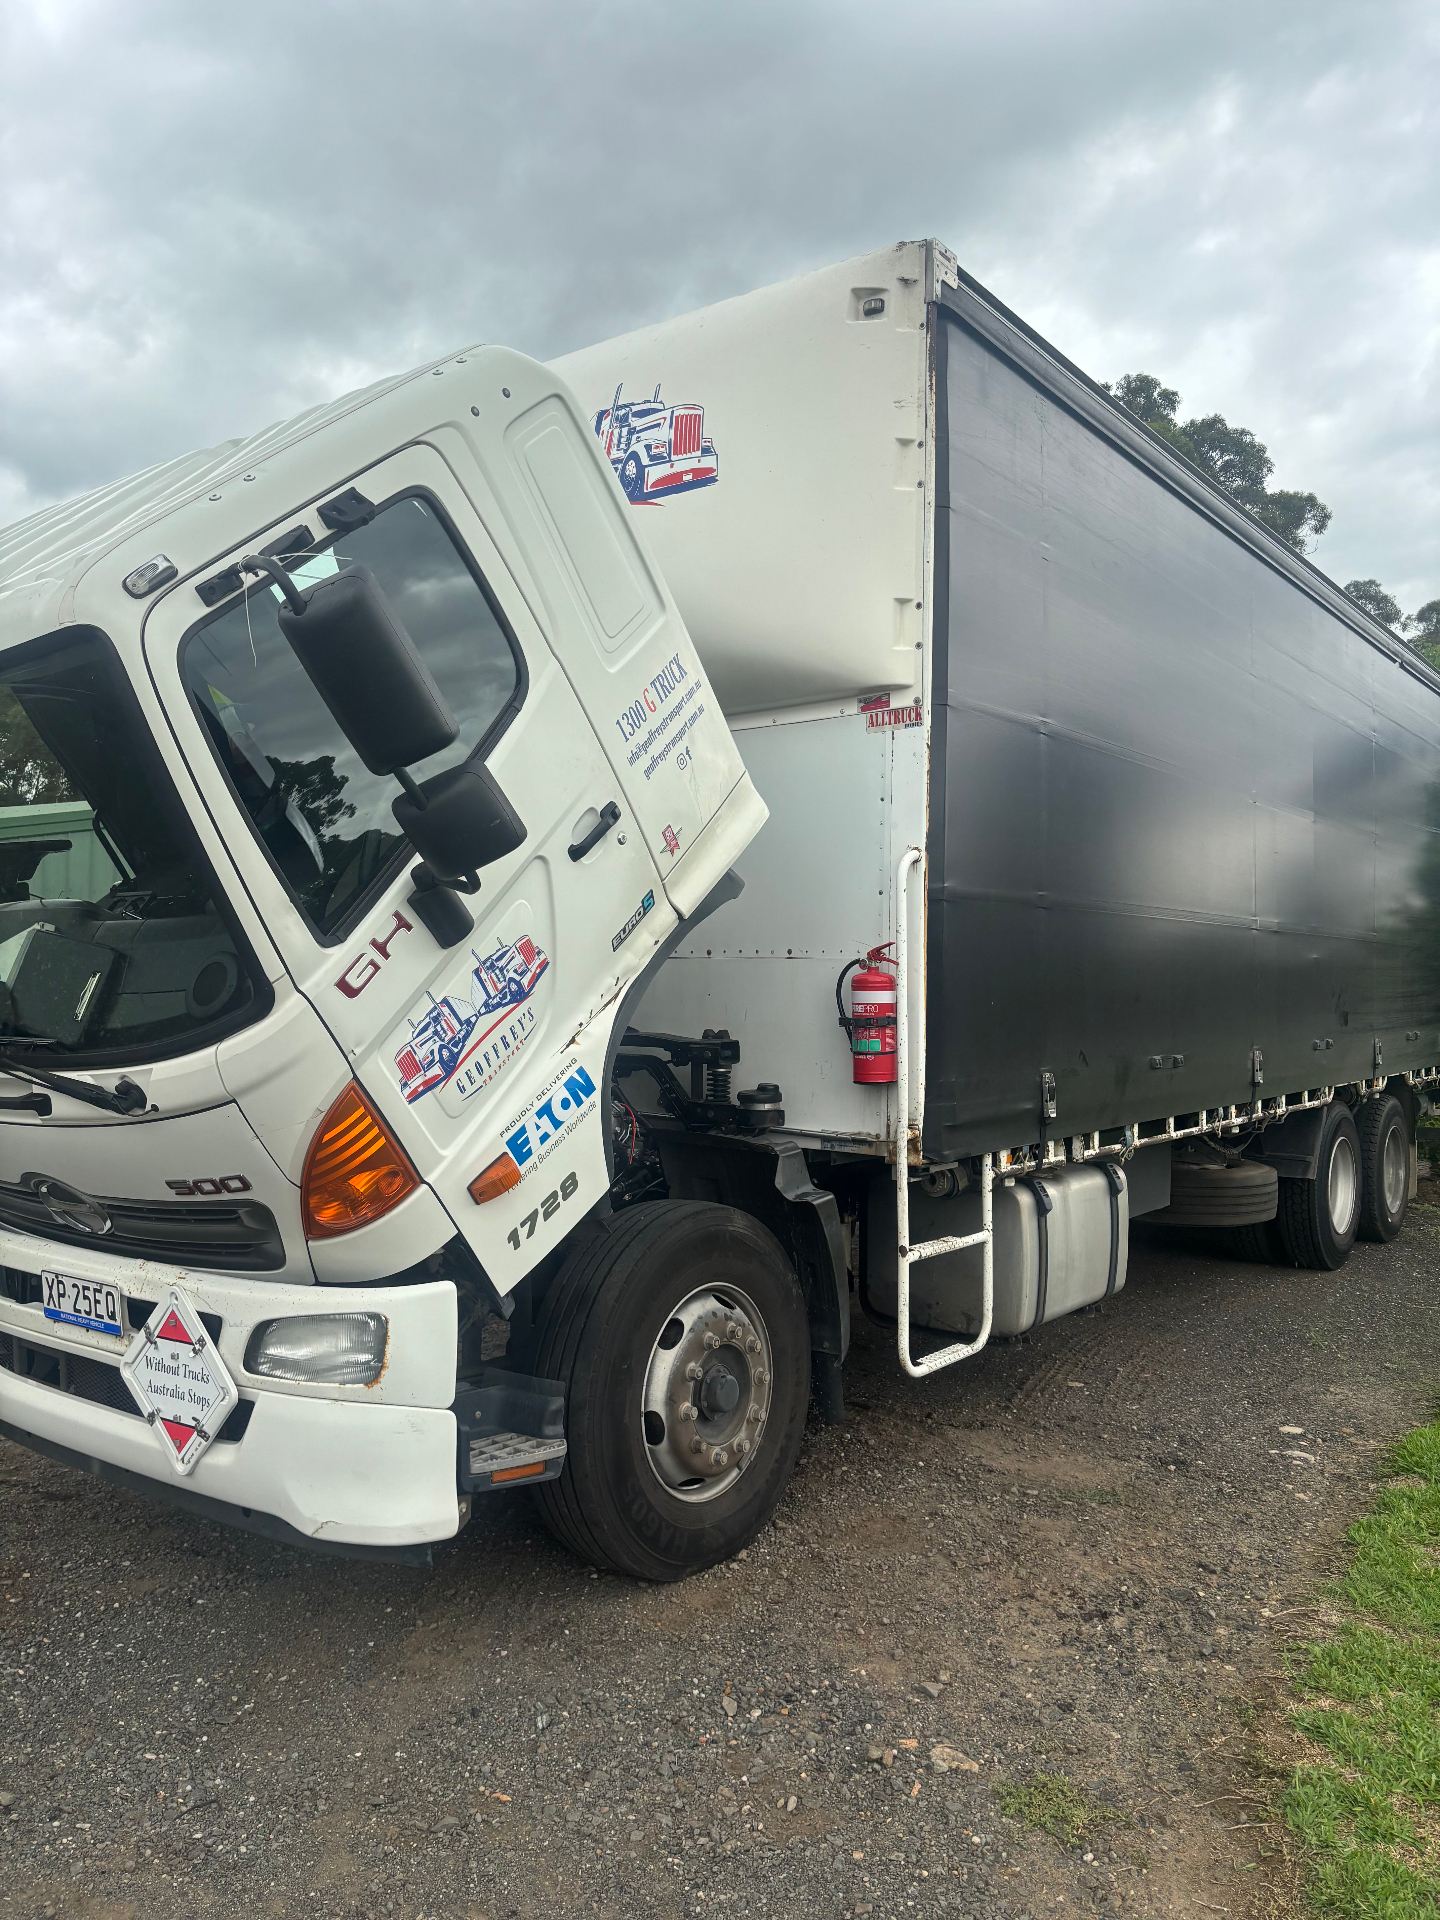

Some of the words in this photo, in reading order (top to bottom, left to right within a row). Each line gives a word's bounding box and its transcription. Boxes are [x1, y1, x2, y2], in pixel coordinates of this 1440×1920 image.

[615, 699, 648, 743] 1300
[642, 687, 657, 714] G
[650, 652, 689, 704] TRUCK
[626, 679, 702, 767] info@geoffreystransport.com.au
[867, 706, 923, 728] ALLTRUCK
[643, 703, 705, 781] geoffreystransport.com.au
[334, 910, 414, 999] GH
[456, 1006, 536, 1095] GEOFFREY'S
[482, 1039, 525, 1087] TRANSPORT
[500, 1101, 535, 1138] PROUDLY
[535, 1057, 578, 1102] DELIVERING
[506, 1066, 597, 1167] EATON
[165, 1173, 253, 1195] 500
[507, 1160, 539, 1195] ering
[537, 1132, 566, 1165] Business
[564, 1100, 597, 1136] Worldwide
[507, 1171, 579, 1251] 1728
[60, 1312, 77, 1322] NATIONAL
[76, 1316, 90, 1325] HEAVY
[89, 1319, 105, 1329] VEHICLE
[144, 1355, 180, 1377] Without
[181, 1363, 210, 1385] Trucks
[146, 1378, 185, 1401] Australia
[187, 1388, 211, 1412] Stops
